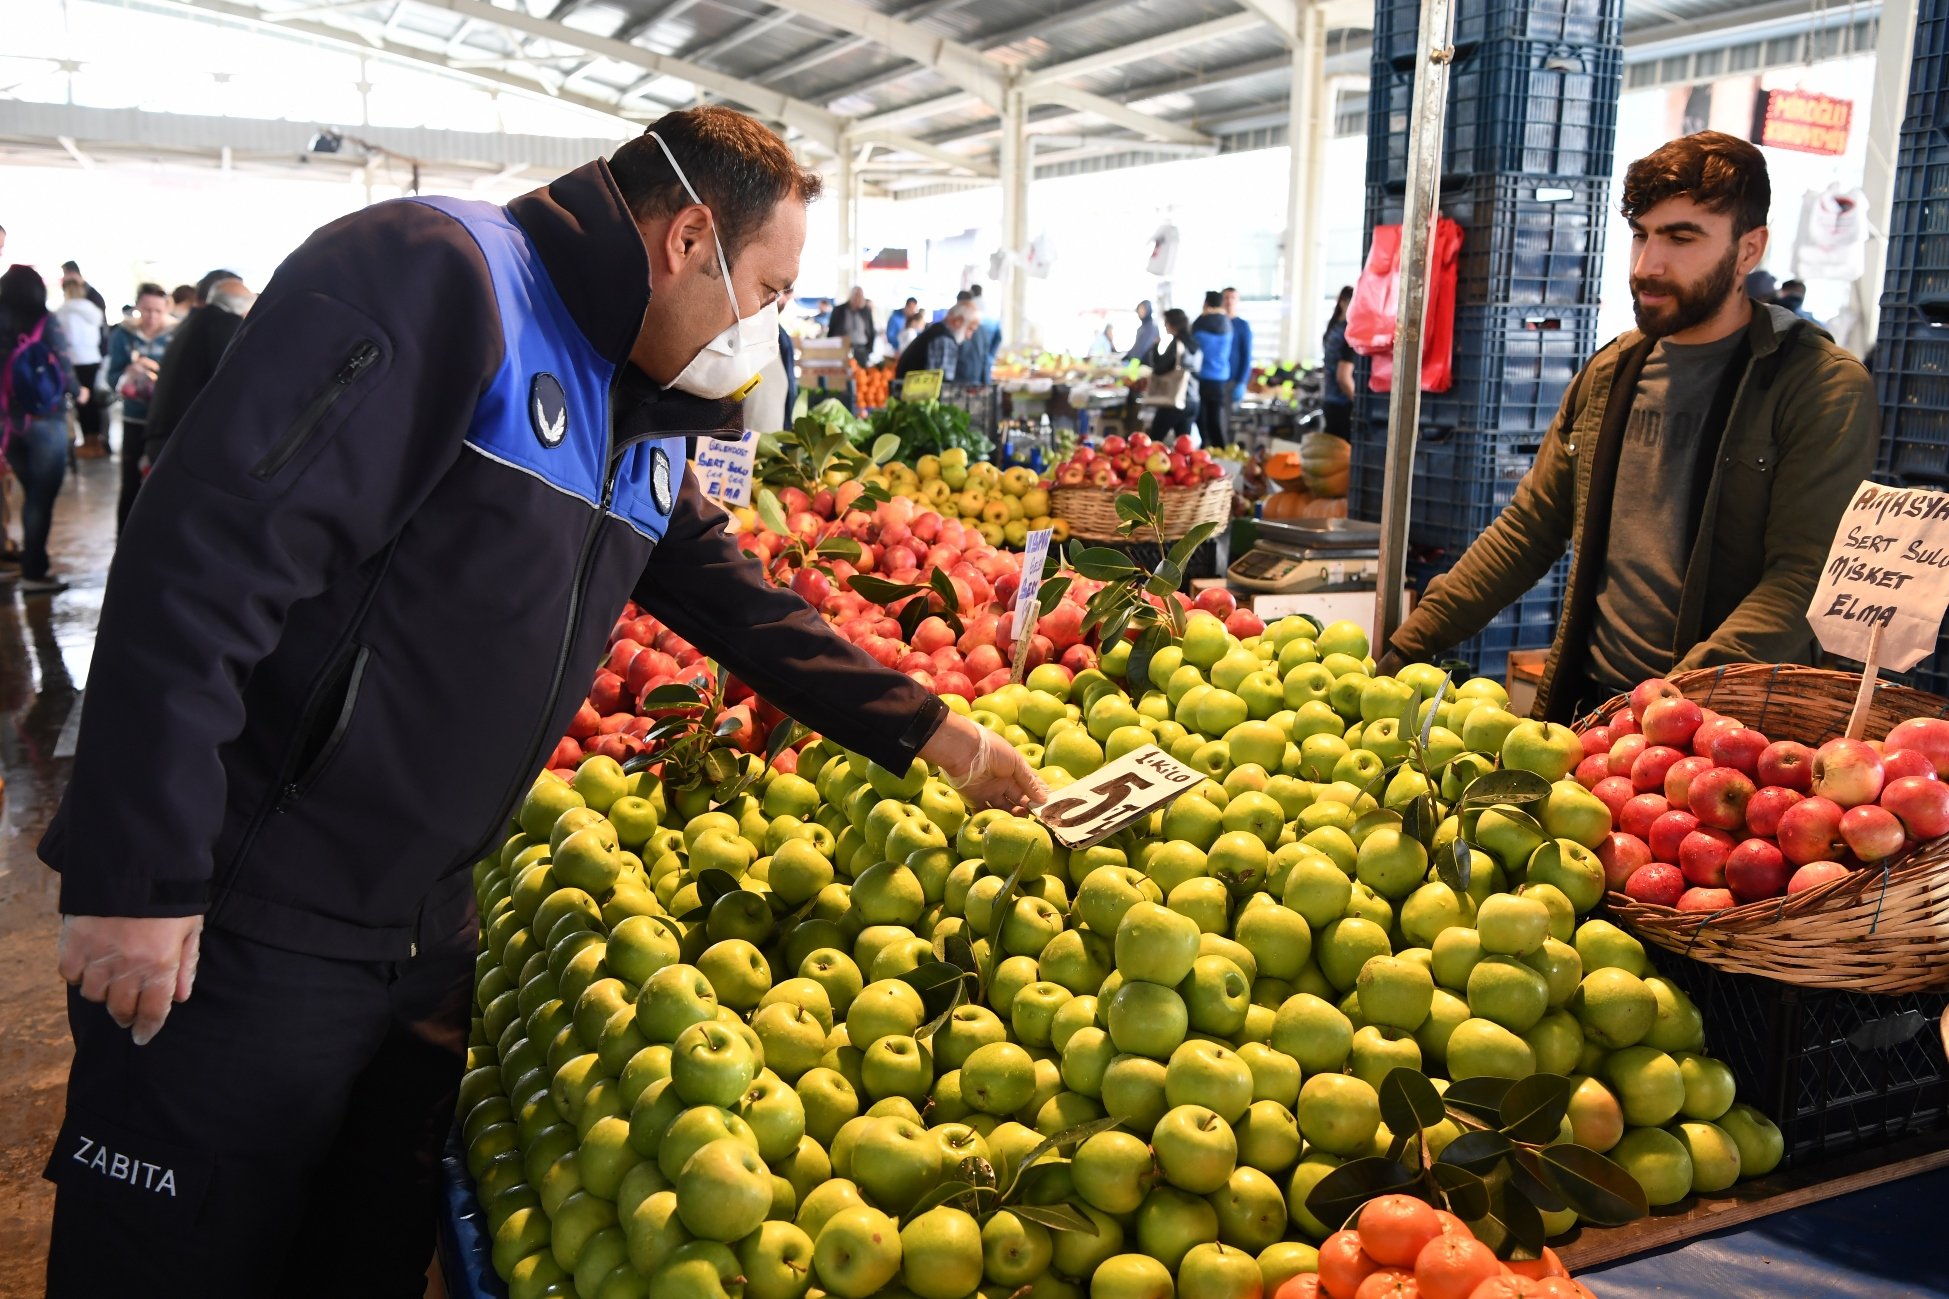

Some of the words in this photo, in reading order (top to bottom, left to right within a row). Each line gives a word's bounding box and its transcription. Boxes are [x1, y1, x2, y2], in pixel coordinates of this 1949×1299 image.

[698, 452, 725, 469] SERT
[1843, 526, 1898, 553] SERT
[1824, 593, 1898, 628] ELMA
[1040, 772, 1155, 828] 5
[73, 1135, 176, 1196] ZABITA
